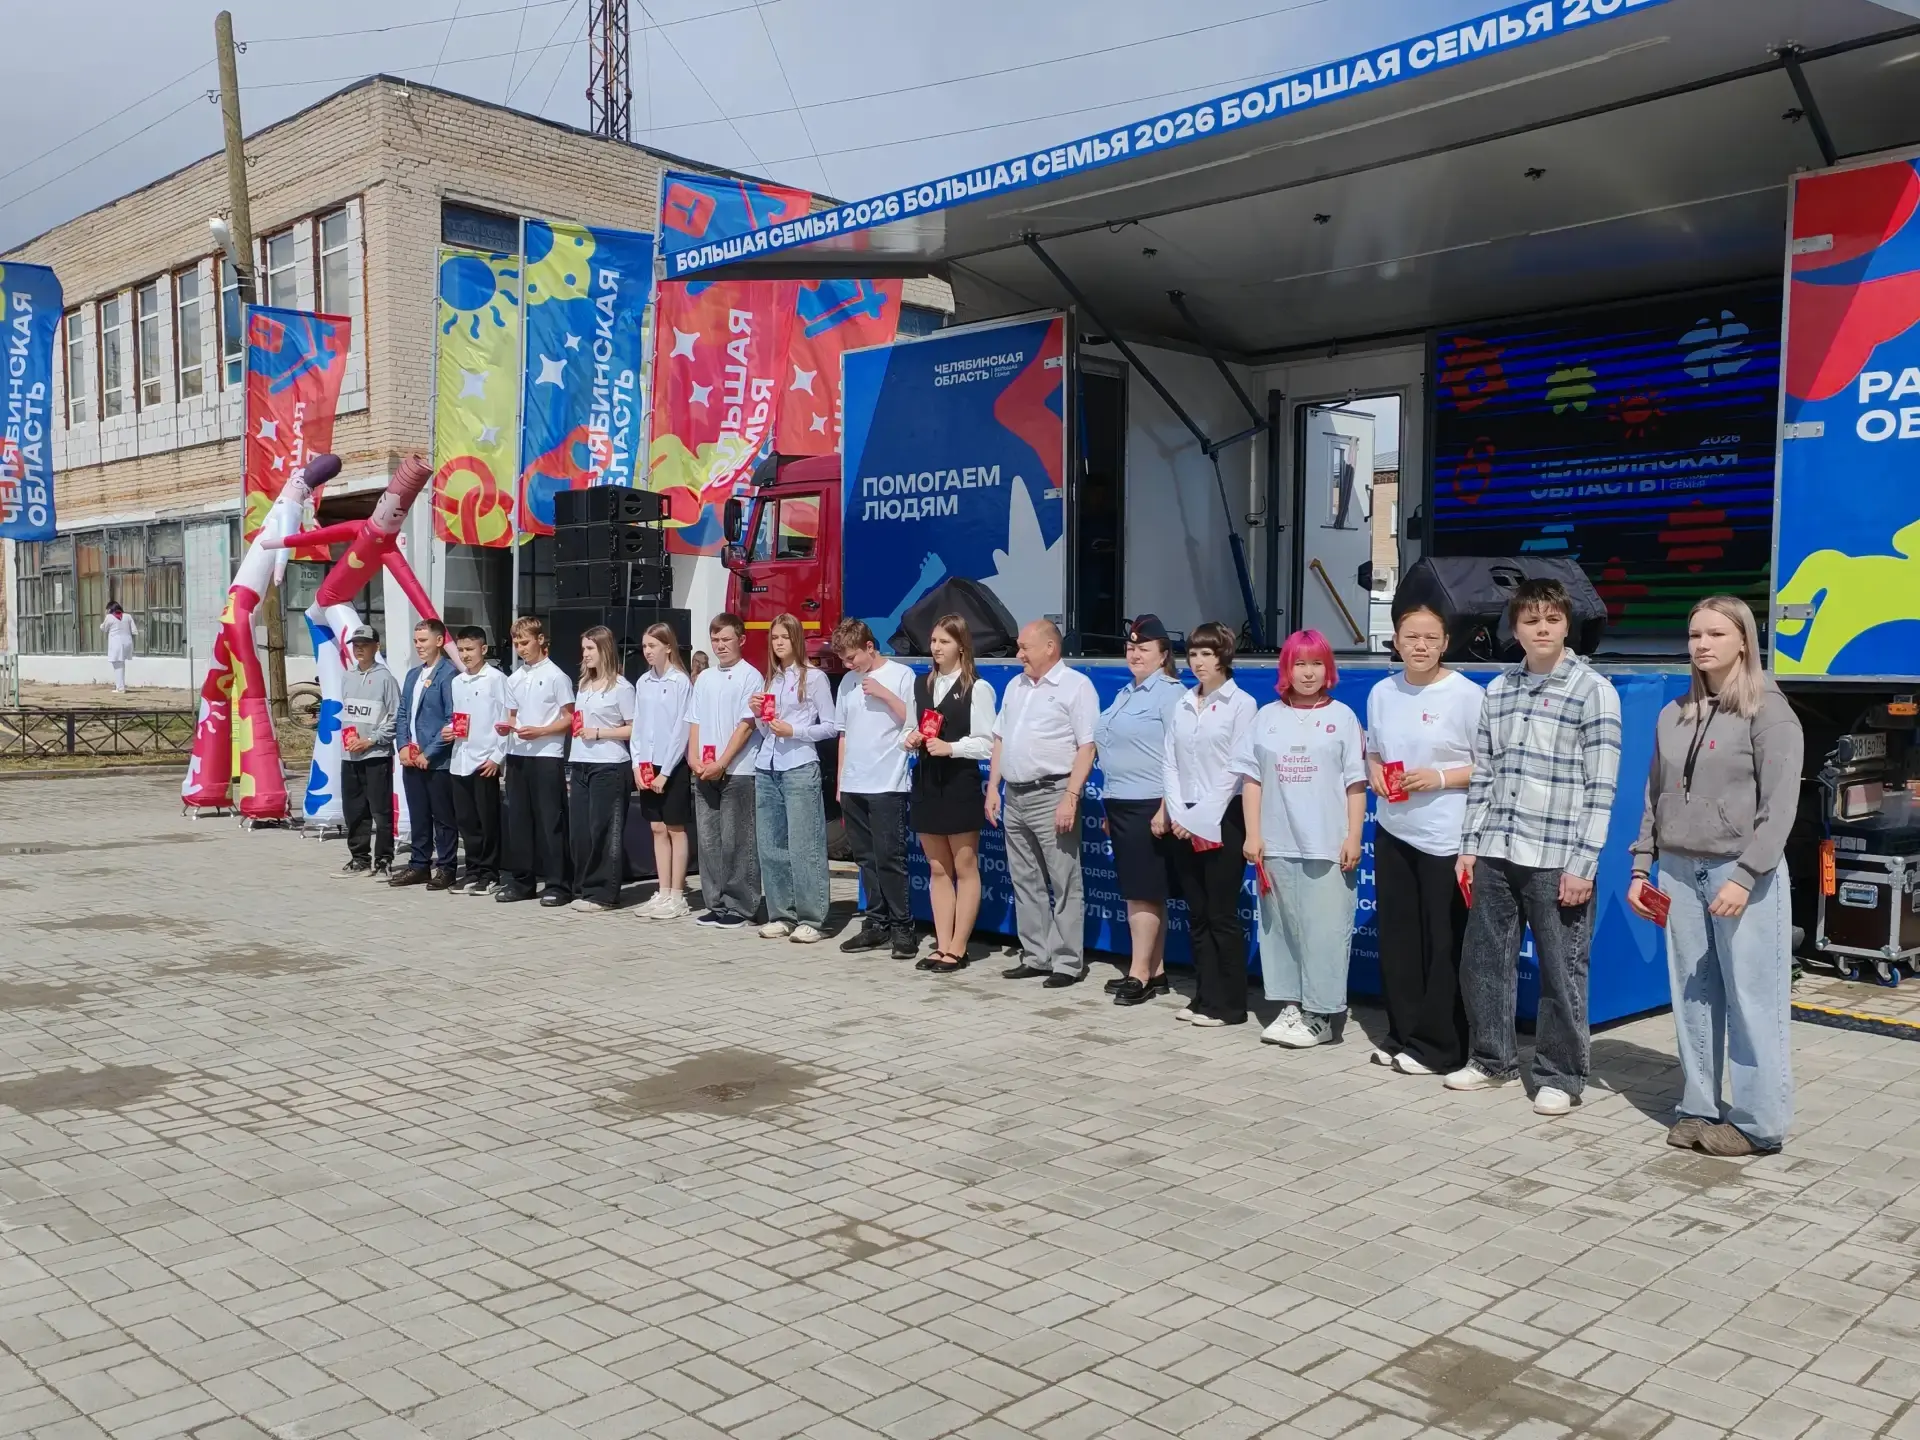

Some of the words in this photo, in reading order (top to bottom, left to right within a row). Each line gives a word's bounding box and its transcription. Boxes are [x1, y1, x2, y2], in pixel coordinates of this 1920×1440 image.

[676, 231, 768, 272] БОЛЬШАЯ
[769, 211, 839, 247] СЕМЬЯ
[842, 195, 899, 229] 2026
[903, 159, 1027, 213] БОЛЬШАЯ
[1031, 130, 1129, 177] СЕМЬЯ
[1134, 106, 1215, 151] 2026
[1220, 49, 1401, 127] БОЛЬШАЯ
[1408, 1, 1553, 70] СЕМЬЯ
[1562, 0, 1649, 26] 20
[934, 351, 1023, 375] ЧЕЛЯБИНСКАЯ
[934, 370, 989, 388] ОБЛАСТЬ
[0, 291, 33, 524] ЧЕЛЯБИНСКАЯ
[23, 382, 47, 527] ОБЛАСТЬ
[862, 464, 1000, 497] ПОМОГАЕМ
[862, 494, 959, 522] ЛЮДЯМ
